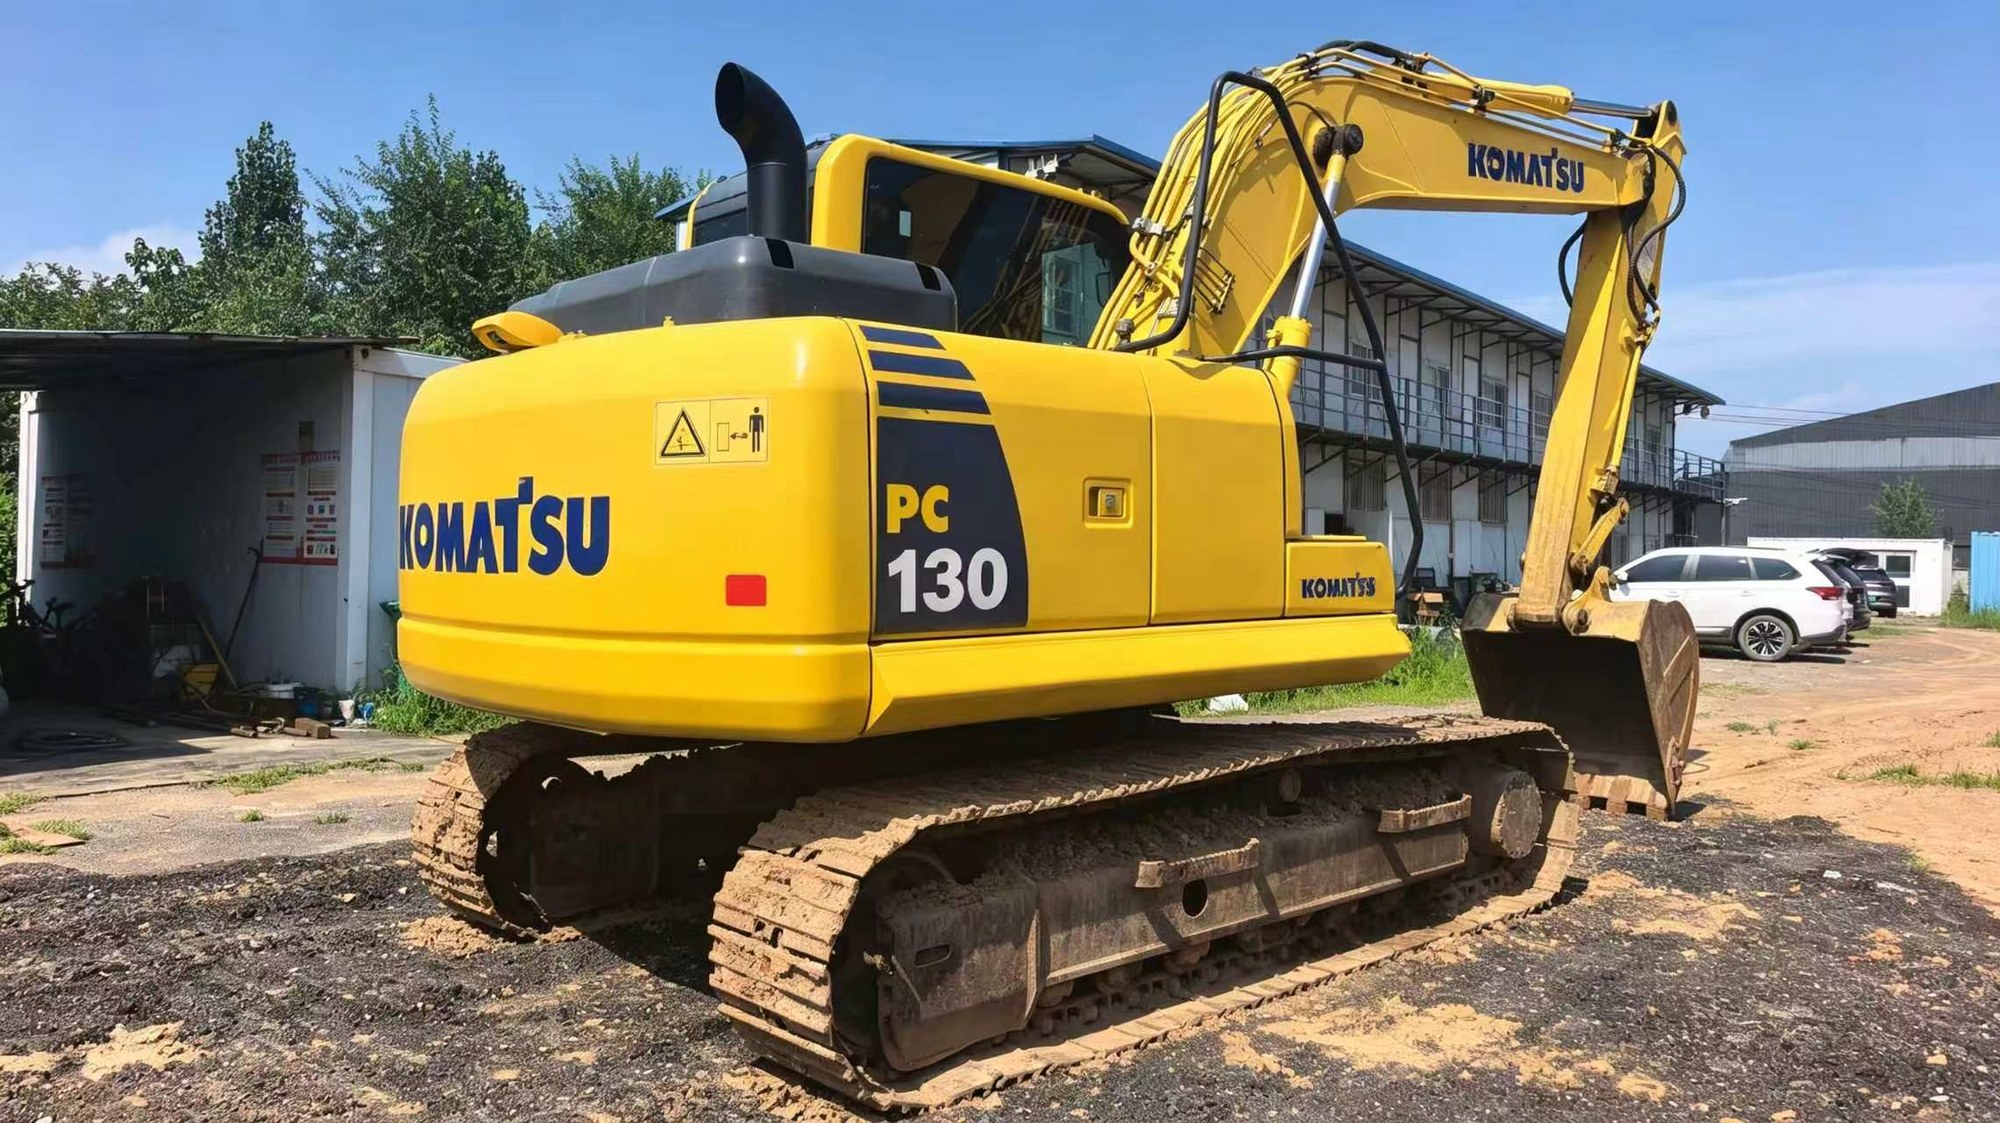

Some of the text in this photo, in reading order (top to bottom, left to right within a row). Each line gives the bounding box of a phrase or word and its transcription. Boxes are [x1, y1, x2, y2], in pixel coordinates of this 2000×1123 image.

[1468, 143, 1584, 192] KOMATSU
[399, 476, 610, 576] KOMATSU
[886, 483, 949, 534] PC
[887, 547, 1008, 613] 130
